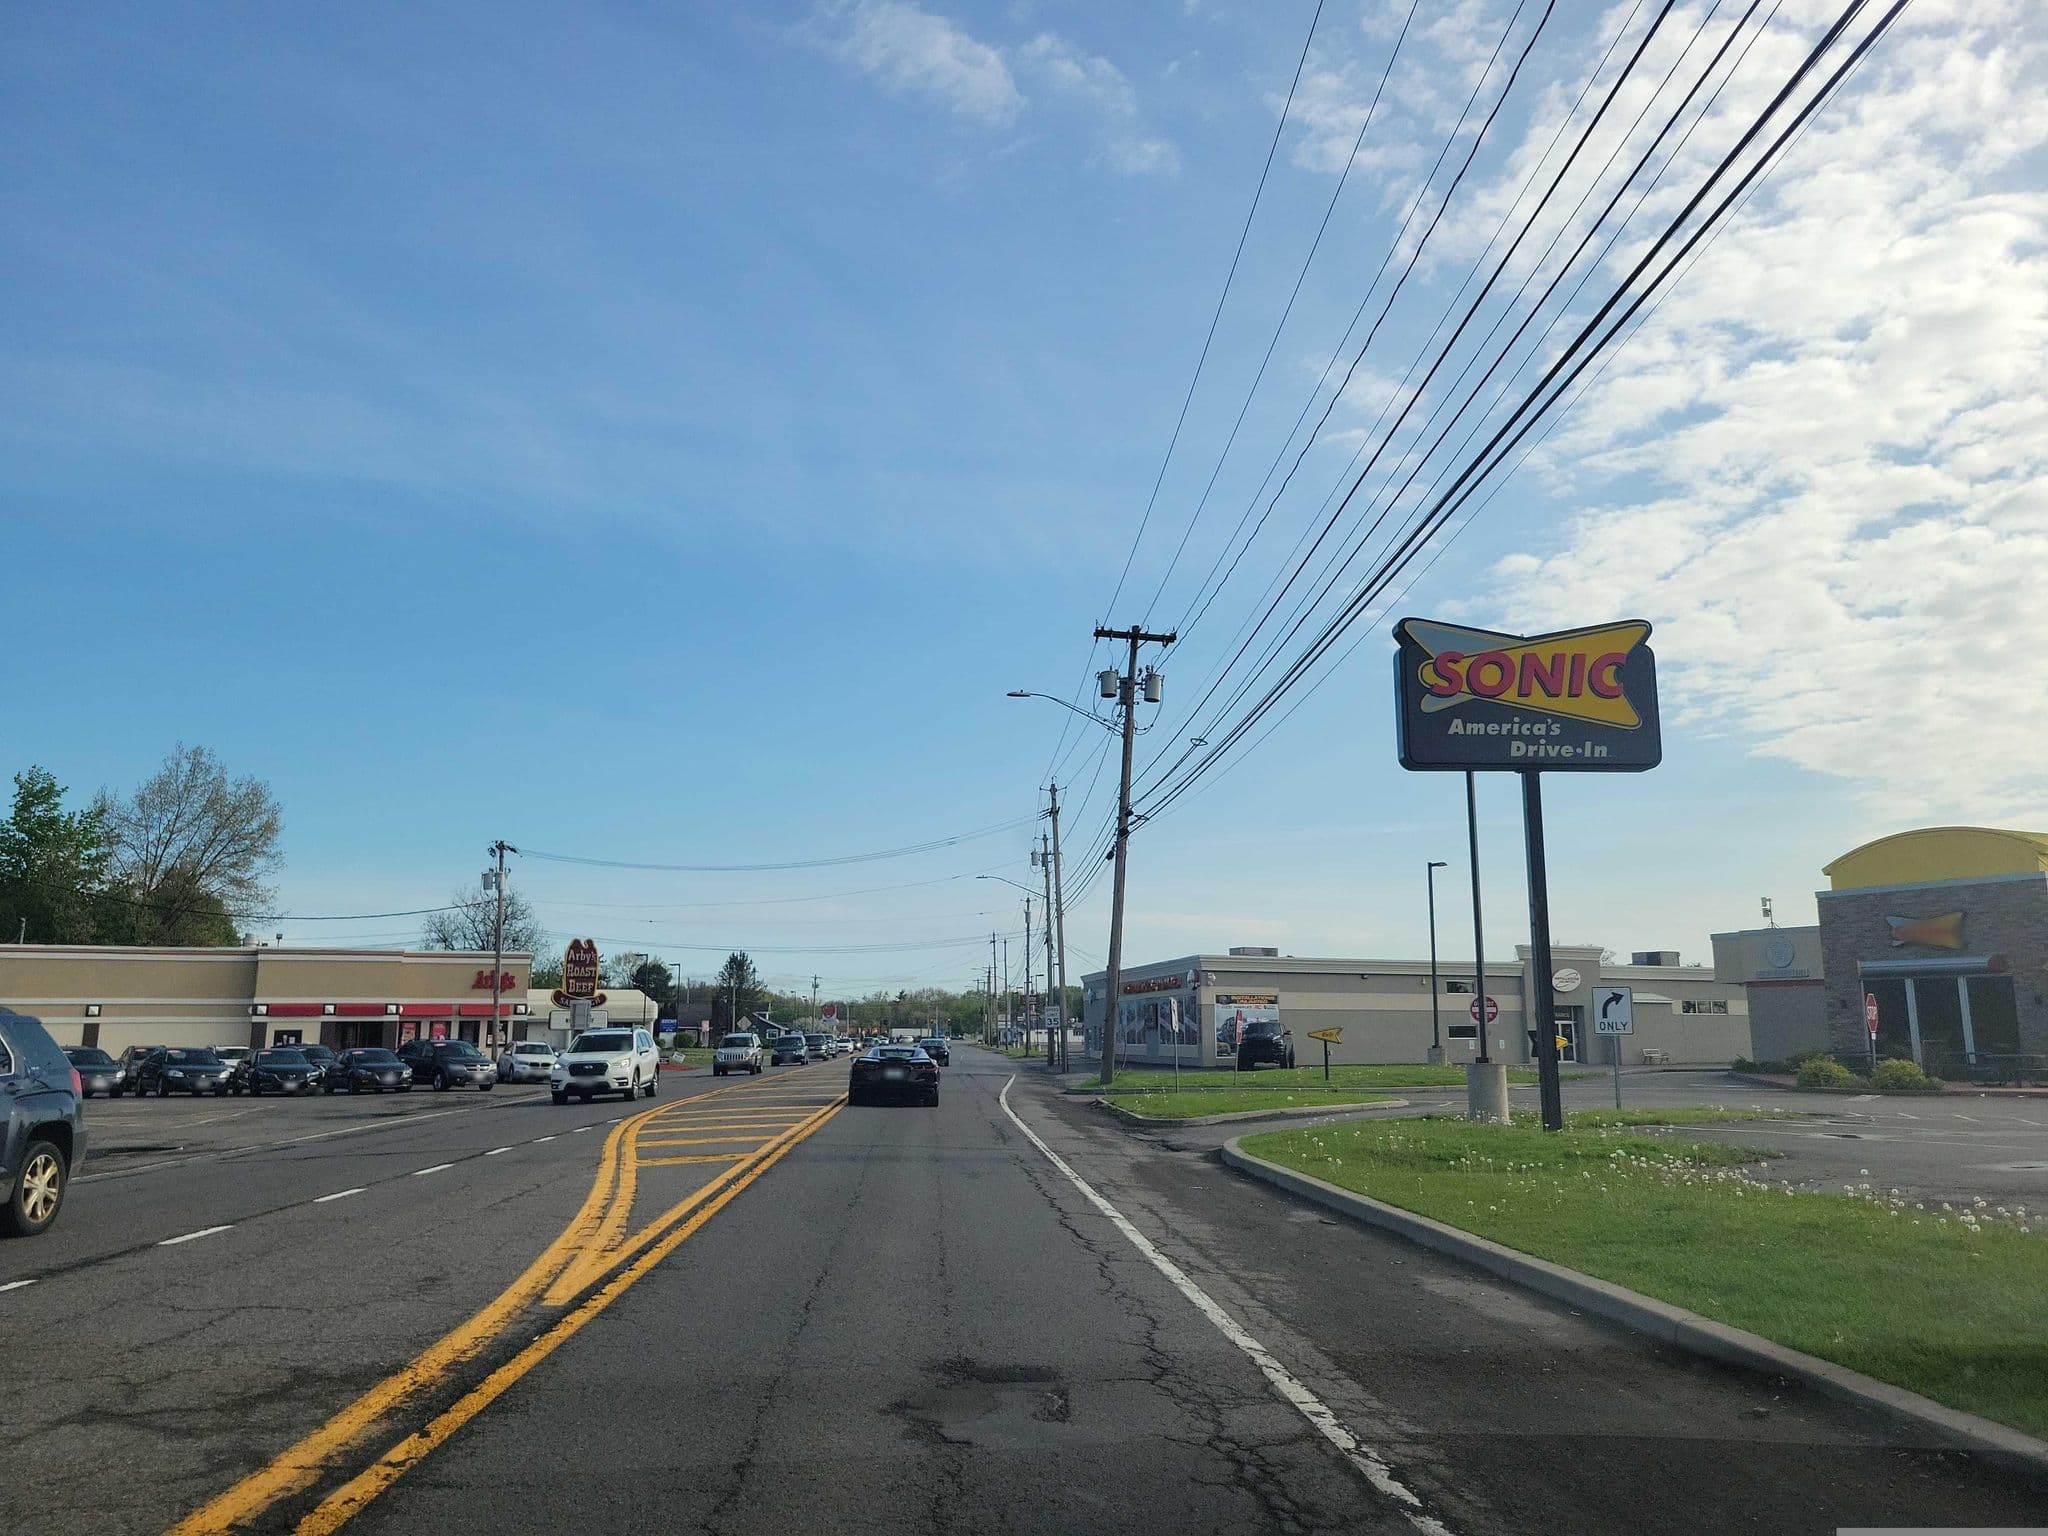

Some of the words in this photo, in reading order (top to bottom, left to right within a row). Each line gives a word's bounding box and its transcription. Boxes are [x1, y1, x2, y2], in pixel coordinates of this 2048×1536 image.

[1428, 651, 1628, 699] SONIC
[1447, 717, 1561, 737] America's
[568, 949, 597, 964] Arby's
[566, 964, 597, 977] ROAST
[568, 979, 594, 993] BEEF
[560, 997, 601, 1007] SACH
[1047, 1017, 1060, 1026] 35
[1599, 1021, 1628, 1031] ONLY
